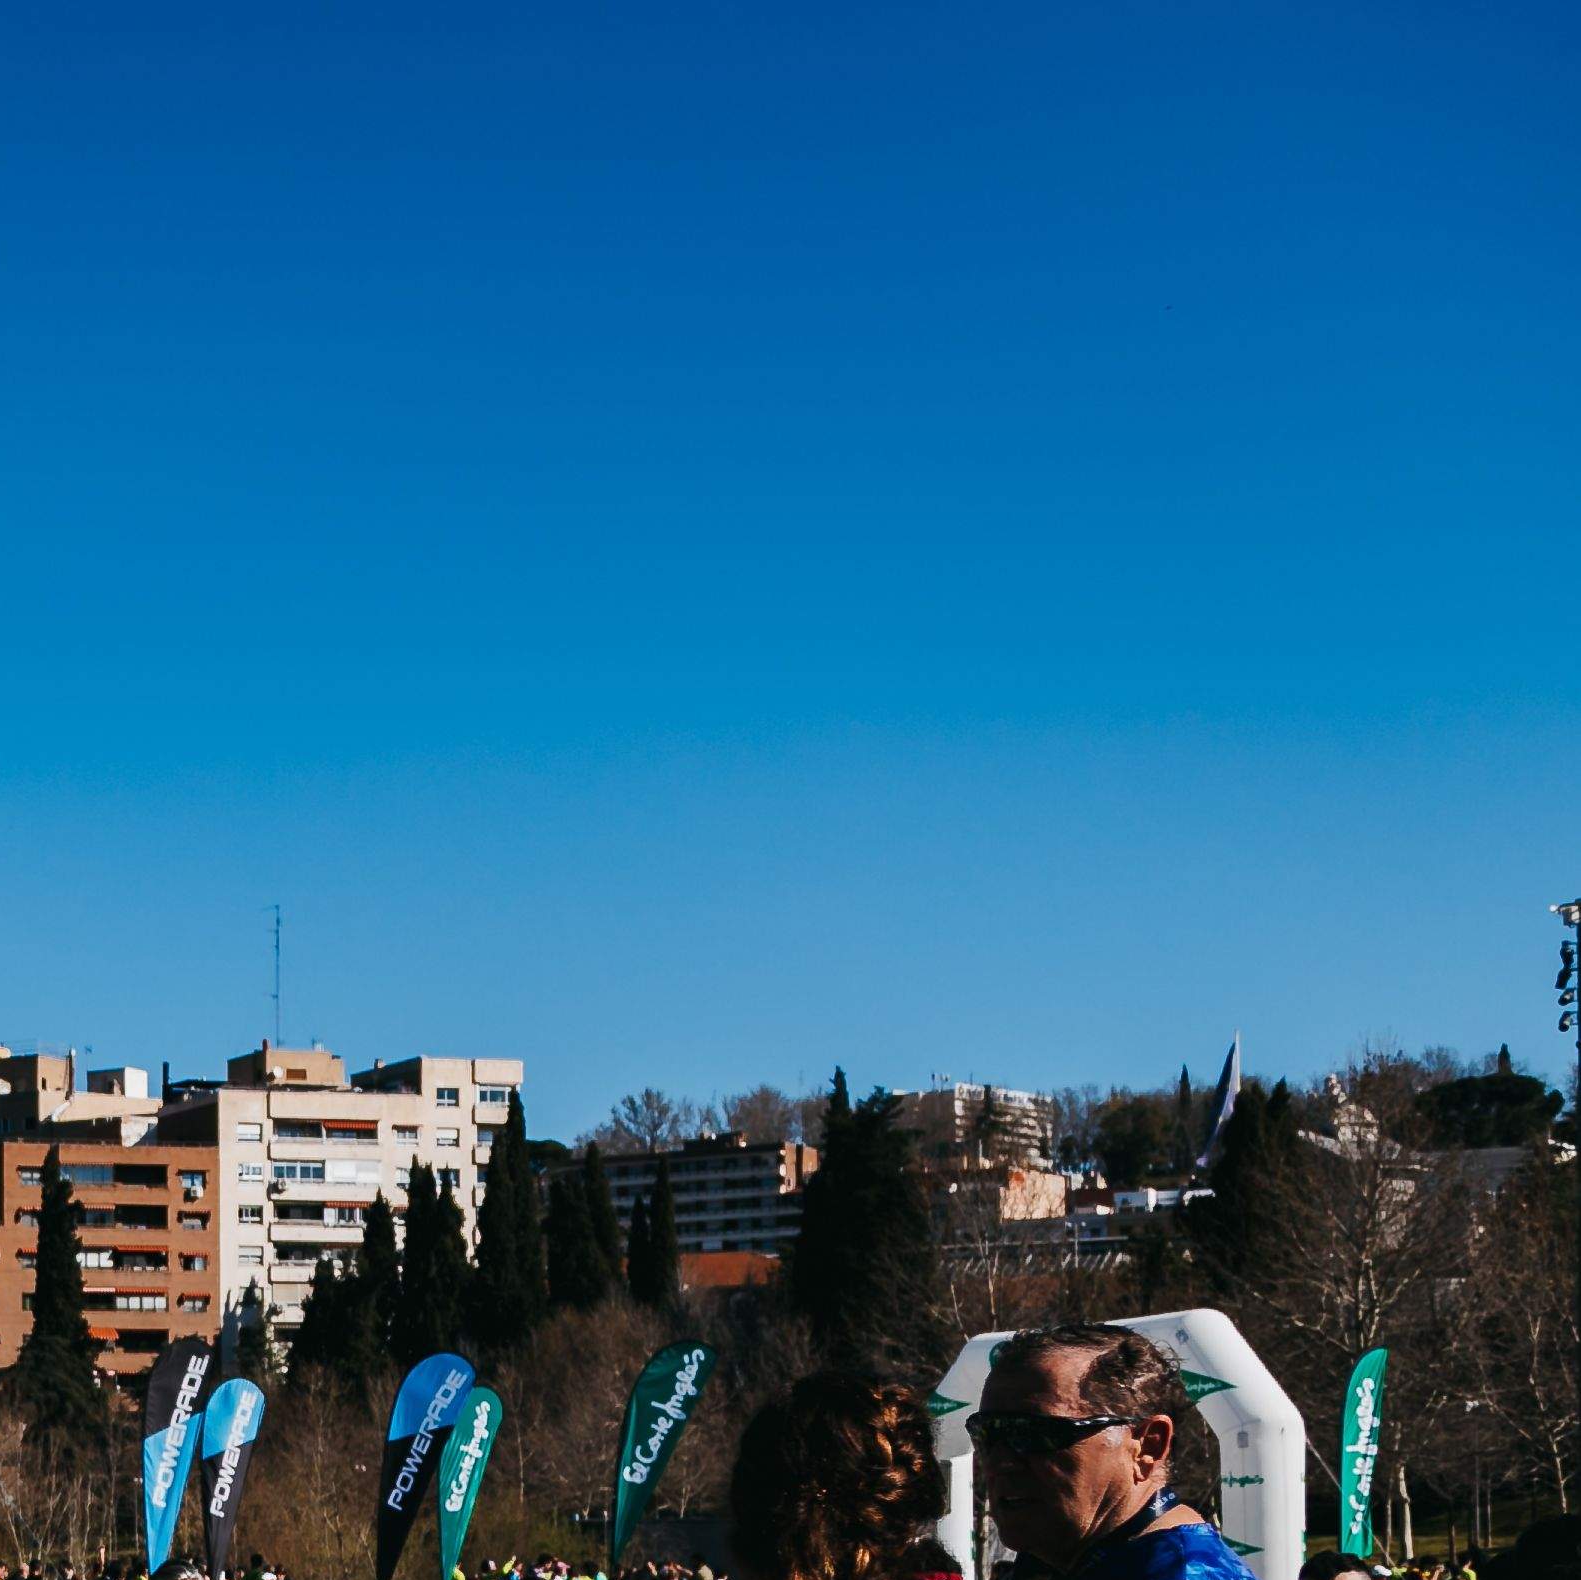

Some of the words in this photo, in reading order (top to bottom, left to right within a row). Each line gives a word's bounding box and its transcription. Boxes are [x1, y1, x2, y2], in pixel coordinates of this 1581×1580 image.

[152, 1355, 210, 1508] POWERADE
[210, 1391, 258, 1518] POWERADE
[388, 1369, 467, 1511] POWERADE
